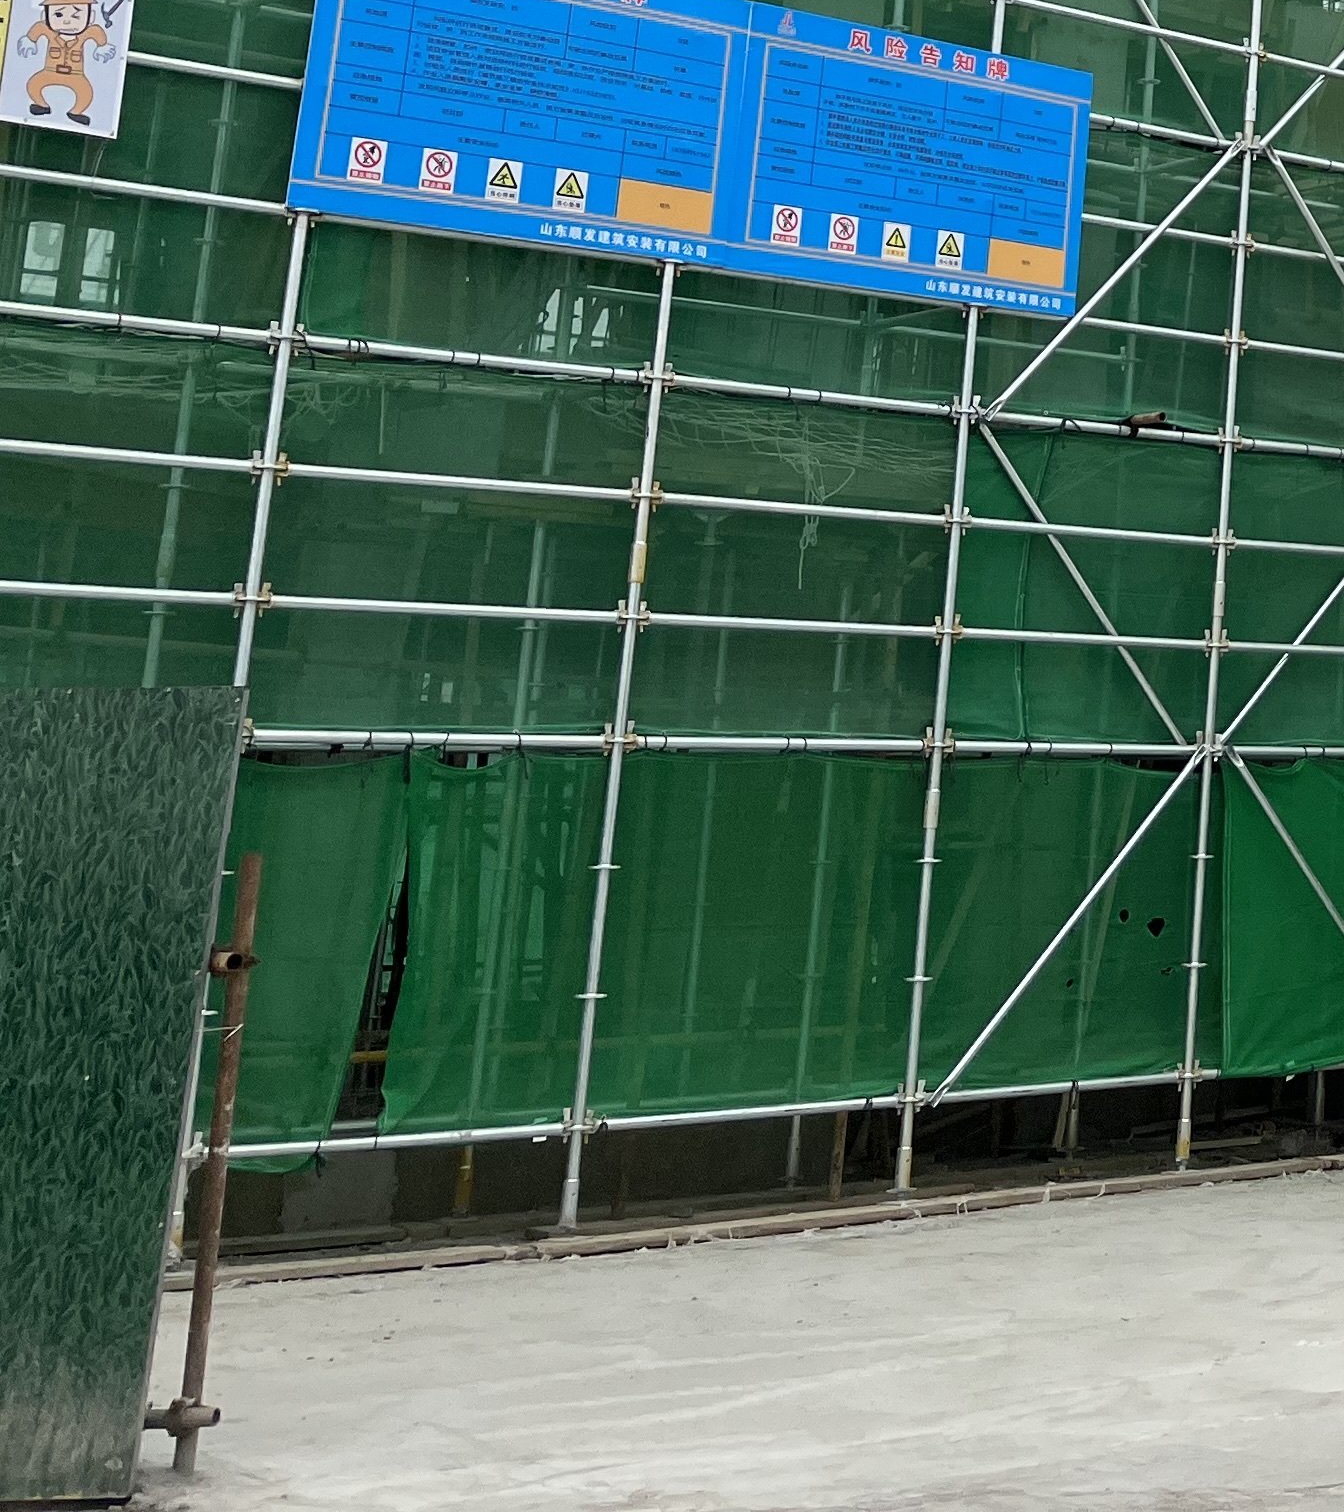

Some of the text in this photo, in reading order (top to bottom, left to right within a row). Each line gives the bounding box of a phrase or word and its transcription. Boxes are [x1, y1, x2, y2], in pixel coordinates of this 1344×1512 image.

[848, 29, 1010, 81] 风险告知牌
[540, 222, 708, 259] 山东顺发建筑安装有限公司
